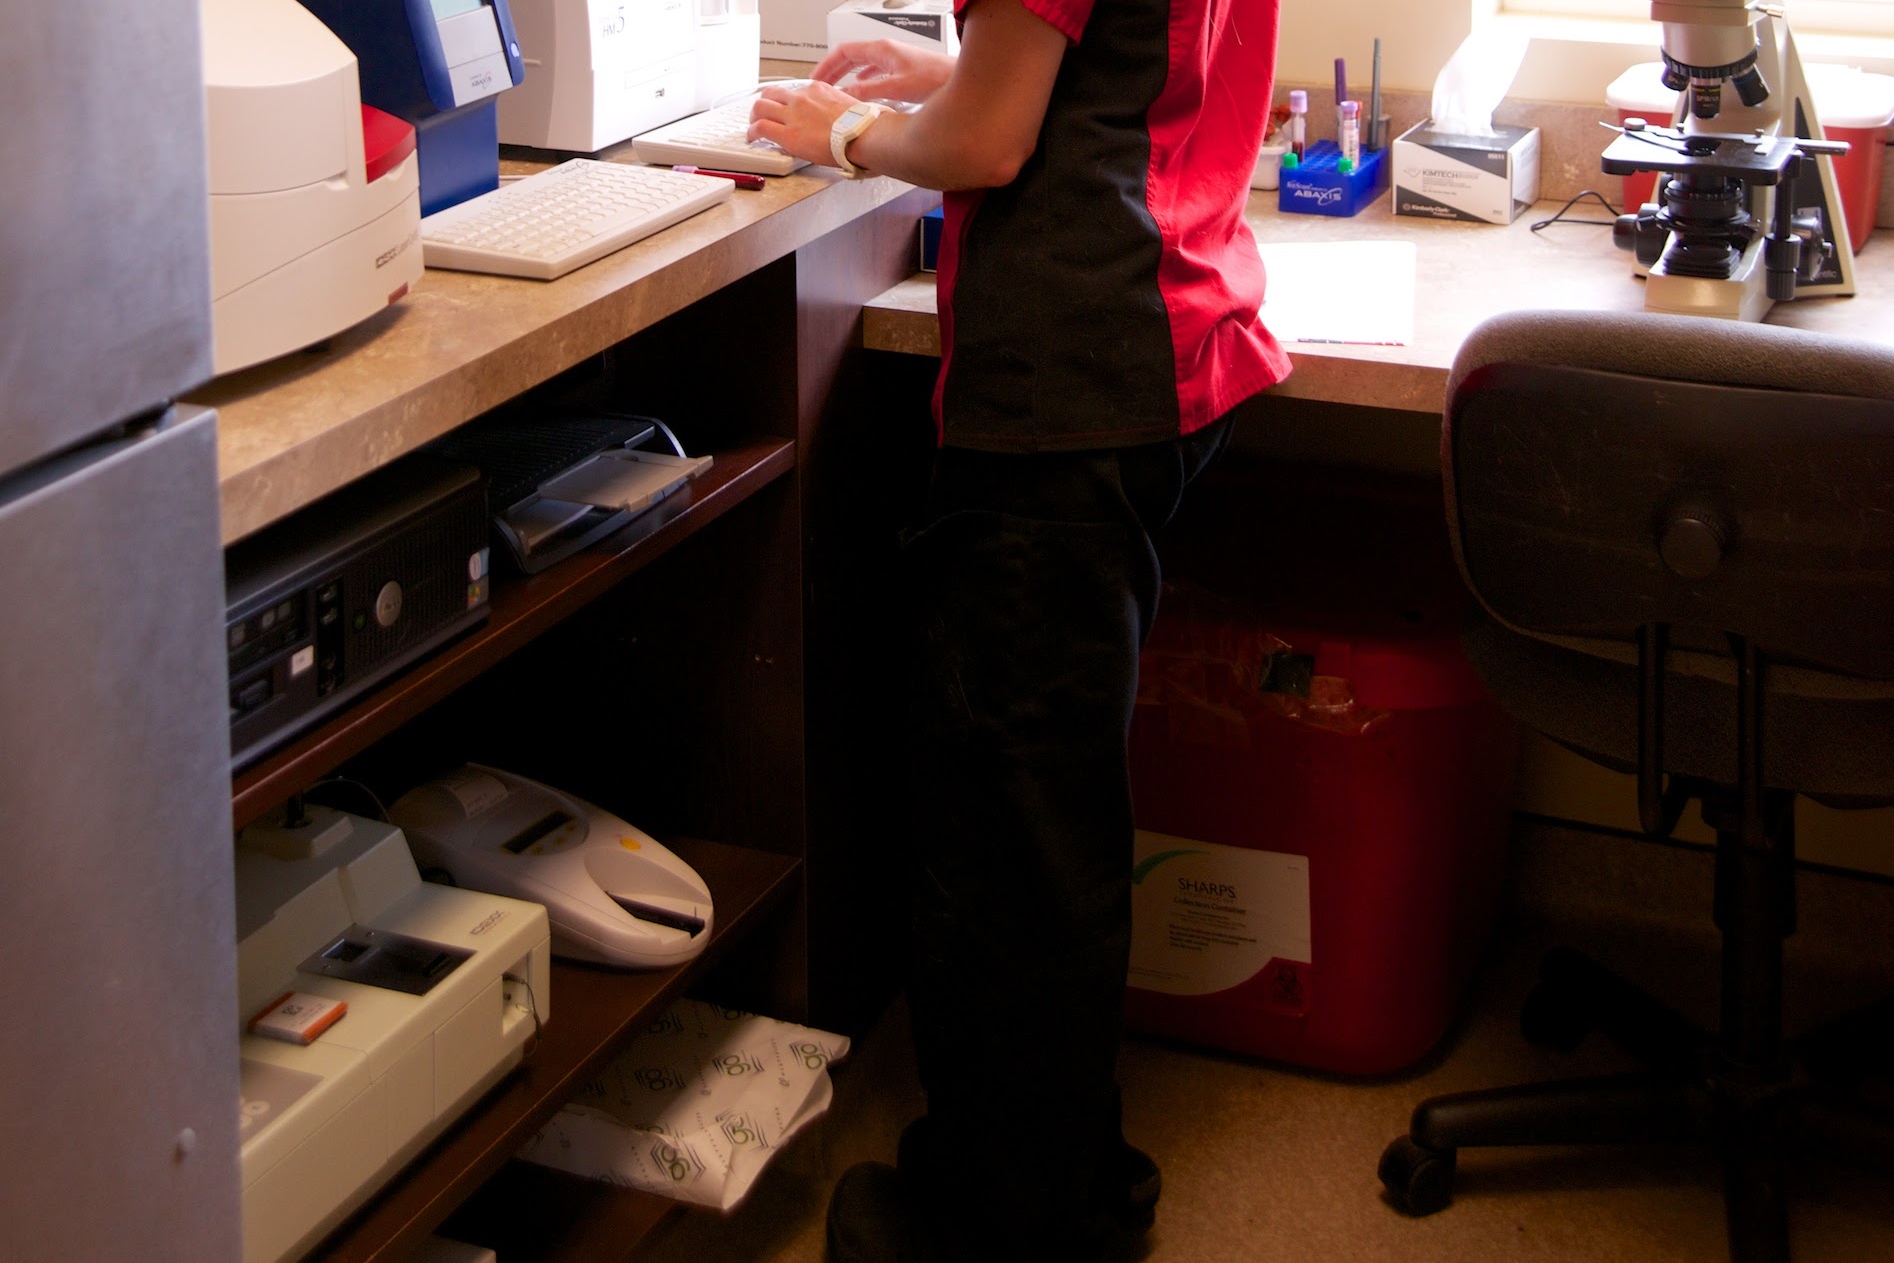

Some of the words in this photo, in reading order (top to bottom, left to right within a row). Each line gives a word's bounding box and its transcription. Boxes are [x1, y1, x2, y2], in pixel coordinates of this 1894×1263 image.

[1422, 169, 1459, 179] KIMTECH
[1294, 188, 1342, 203] ABAXIS
[1178, 878, 1236, 898] SHARPS
